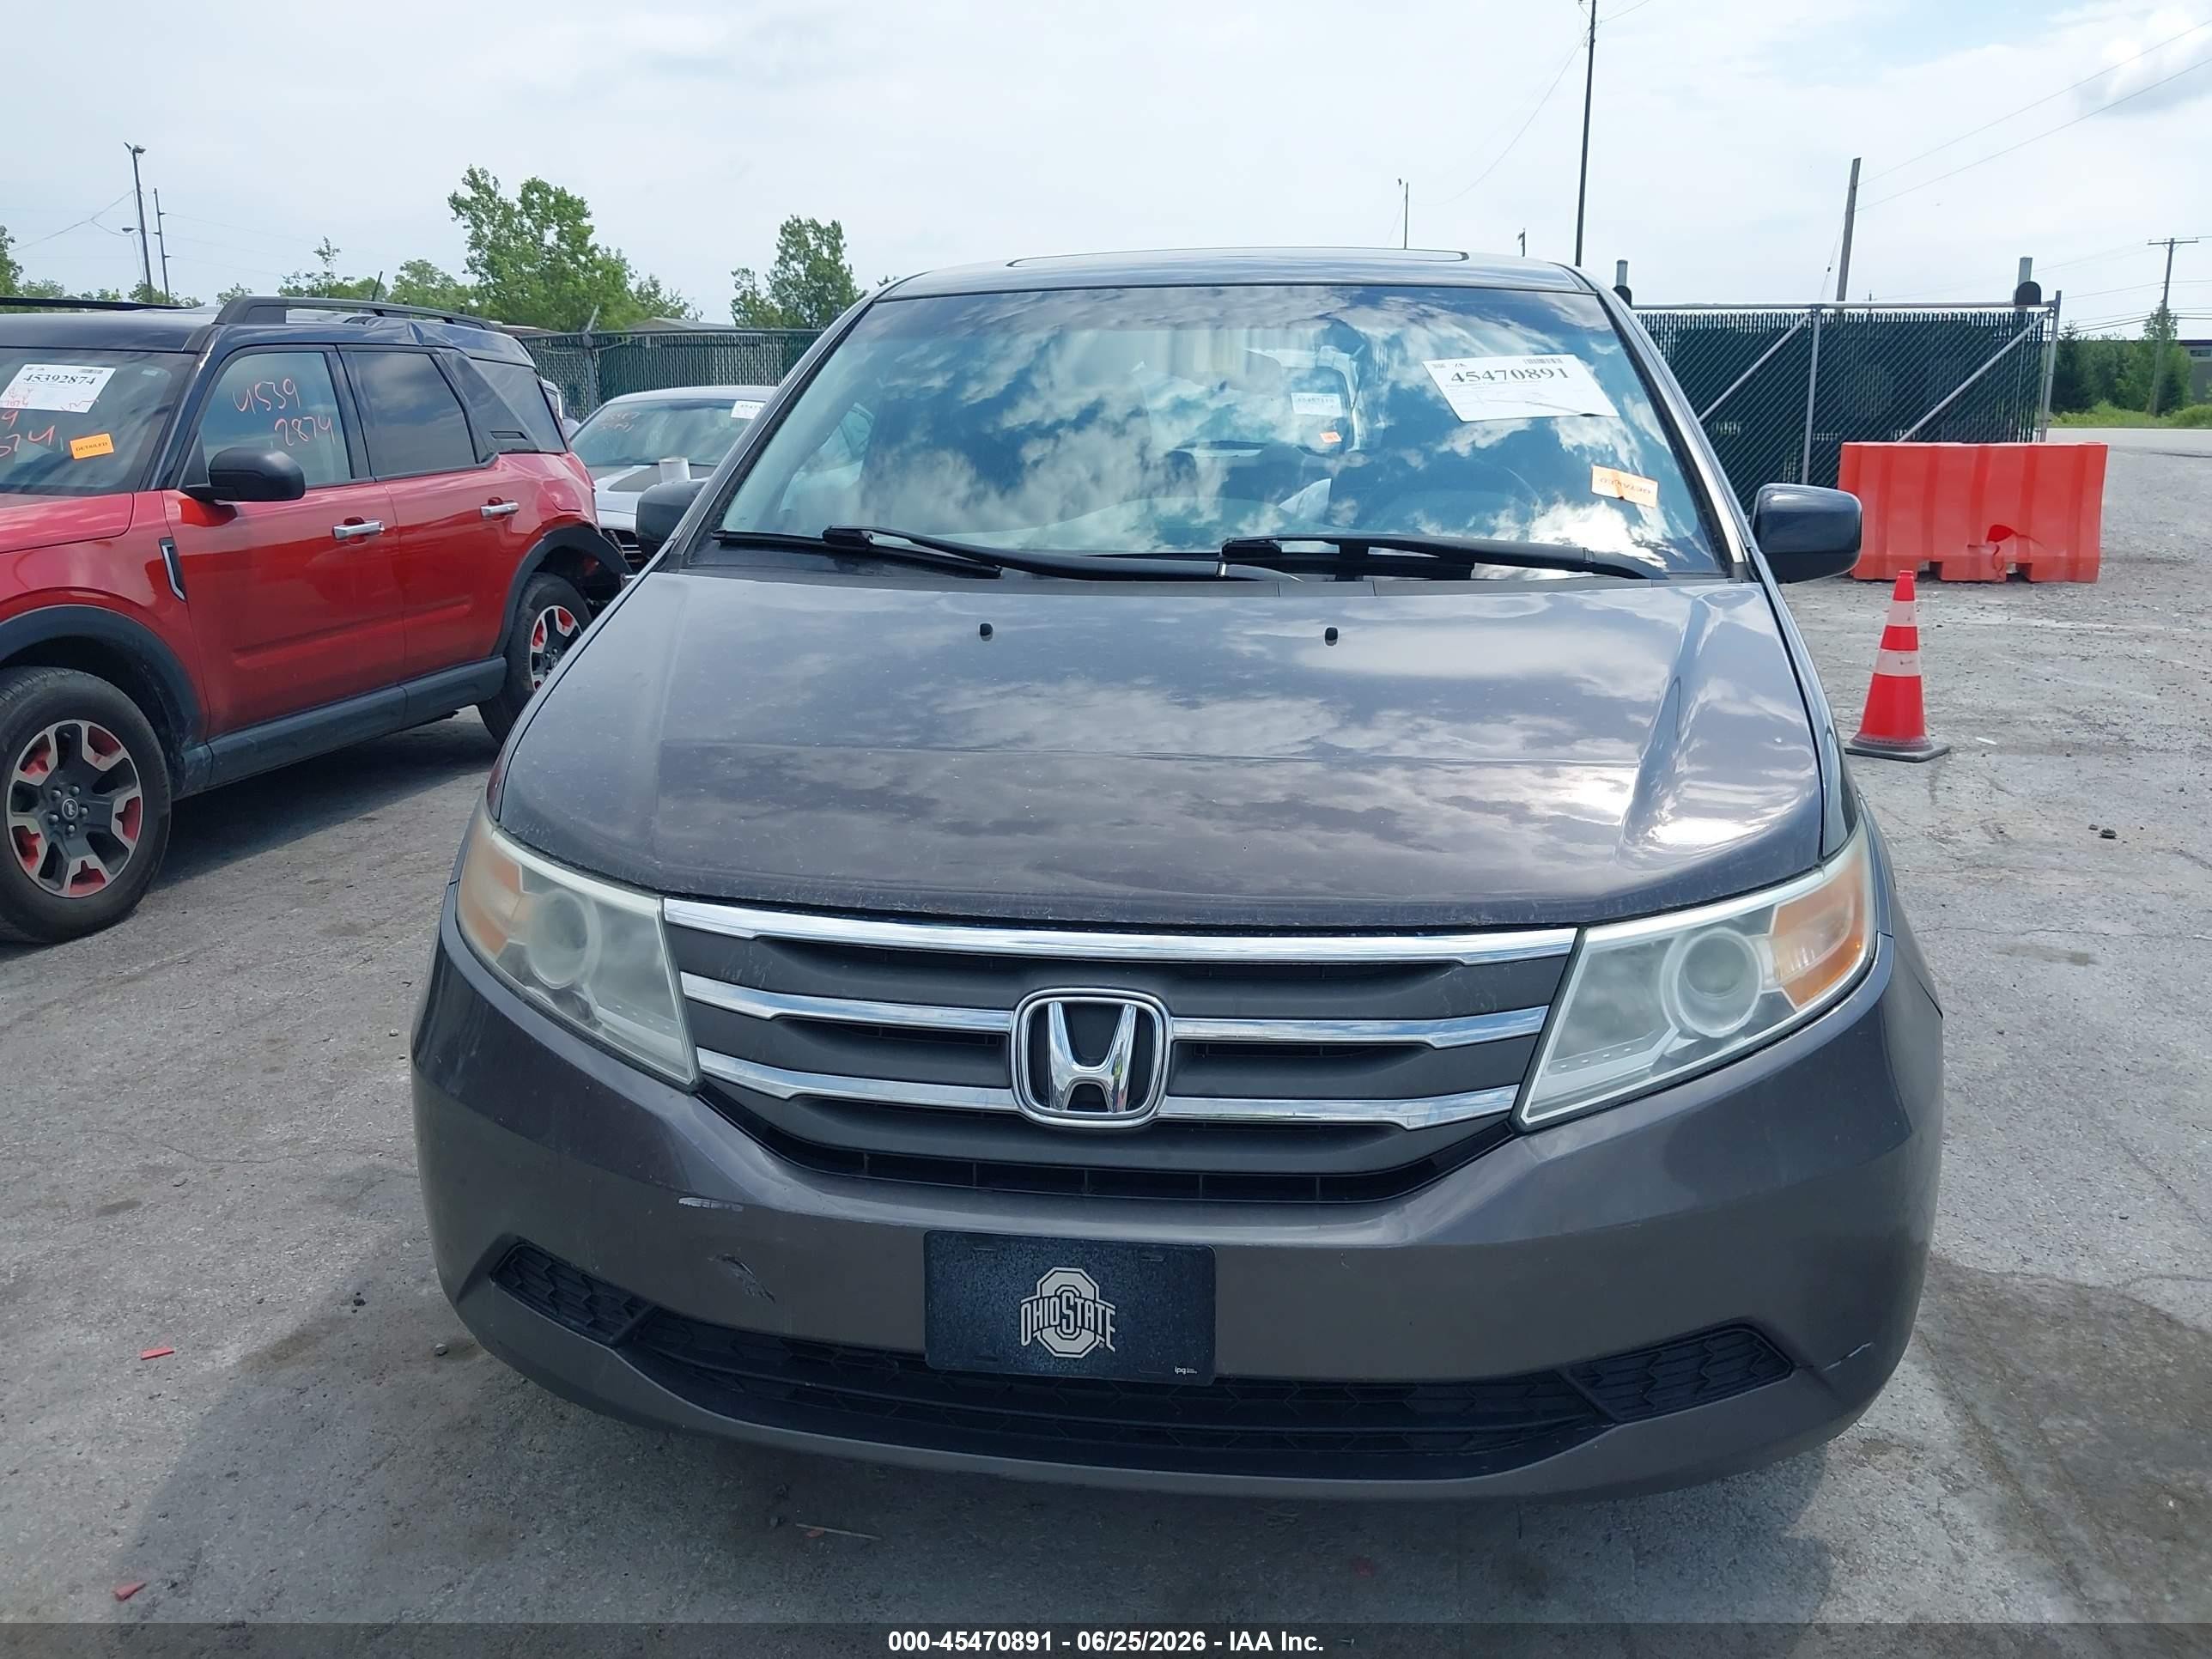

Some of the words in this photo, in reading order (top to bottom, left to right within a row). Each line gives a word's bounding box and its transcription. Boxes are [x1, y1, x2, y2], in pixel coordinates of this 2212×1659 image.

[23, 374, 96, 386] 45392874
[1451, 368, 1571, 383] 45470891
[232, 378, 301, 414] 4539
[274, 415, 336, 447] 2874
